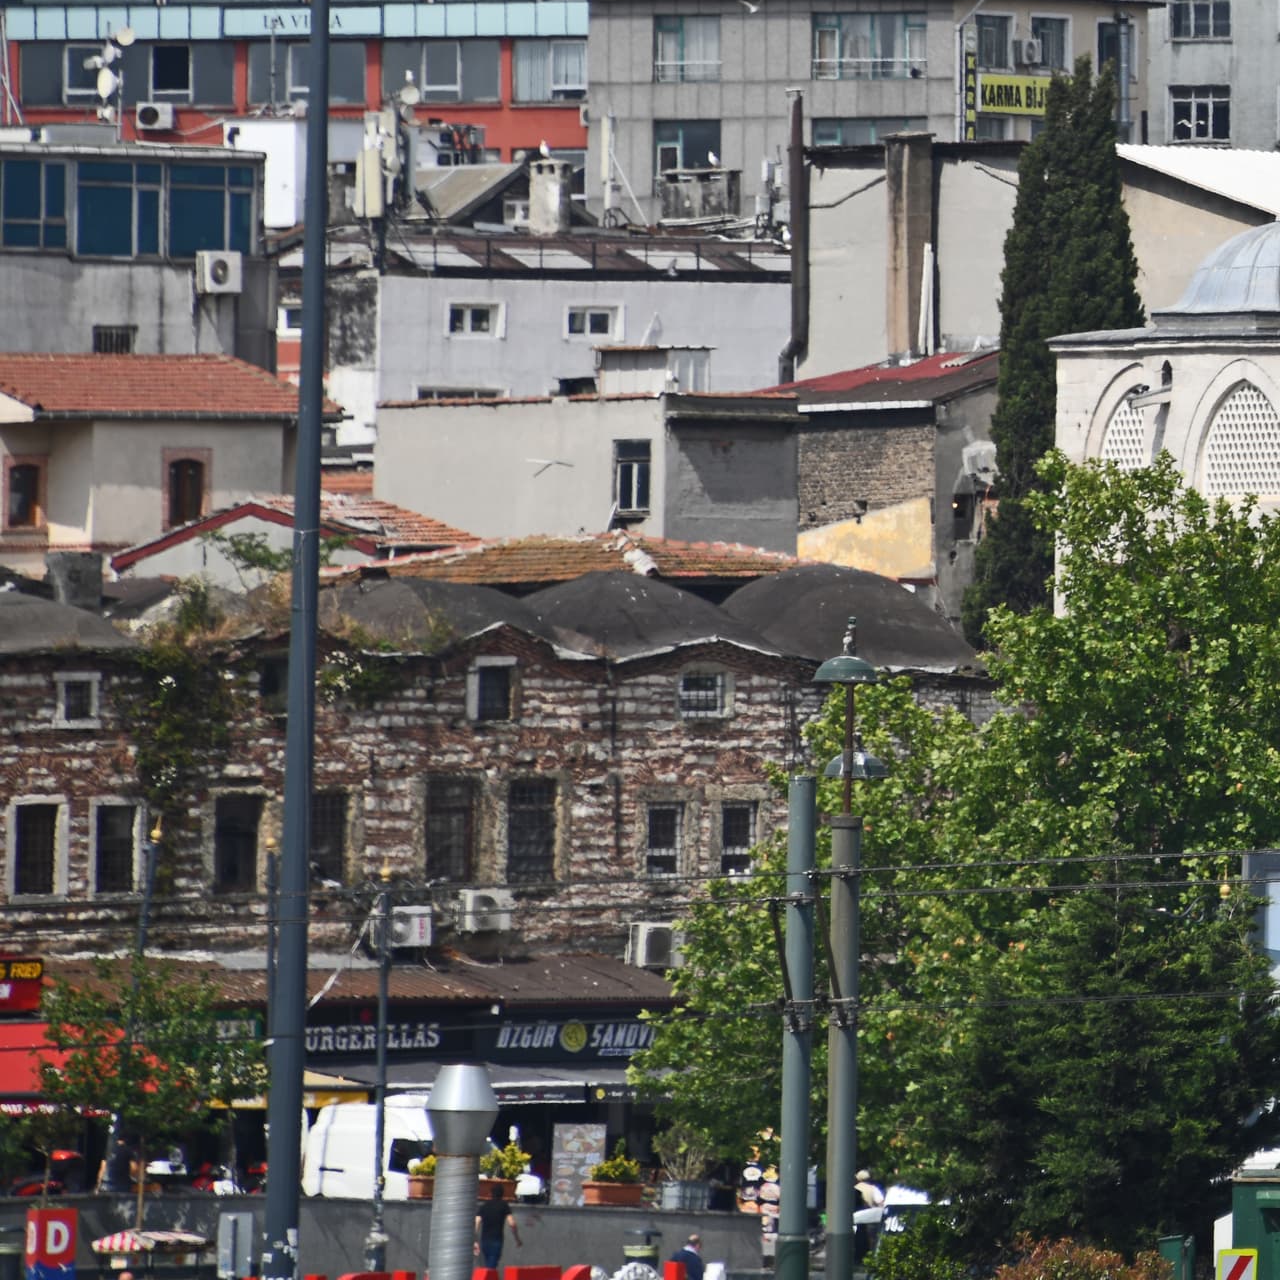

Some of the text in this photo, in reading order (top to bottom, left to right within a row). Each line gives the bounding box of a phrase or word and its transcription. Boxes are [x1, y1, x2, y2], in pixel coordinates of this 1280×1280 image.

[291, 14, 342, 29] VIA
[981, 84, 1022, 108] KARMA
[496, 1020, 557, 1048] ÖZGÜR
[46, 1220, 69, 1254] D
